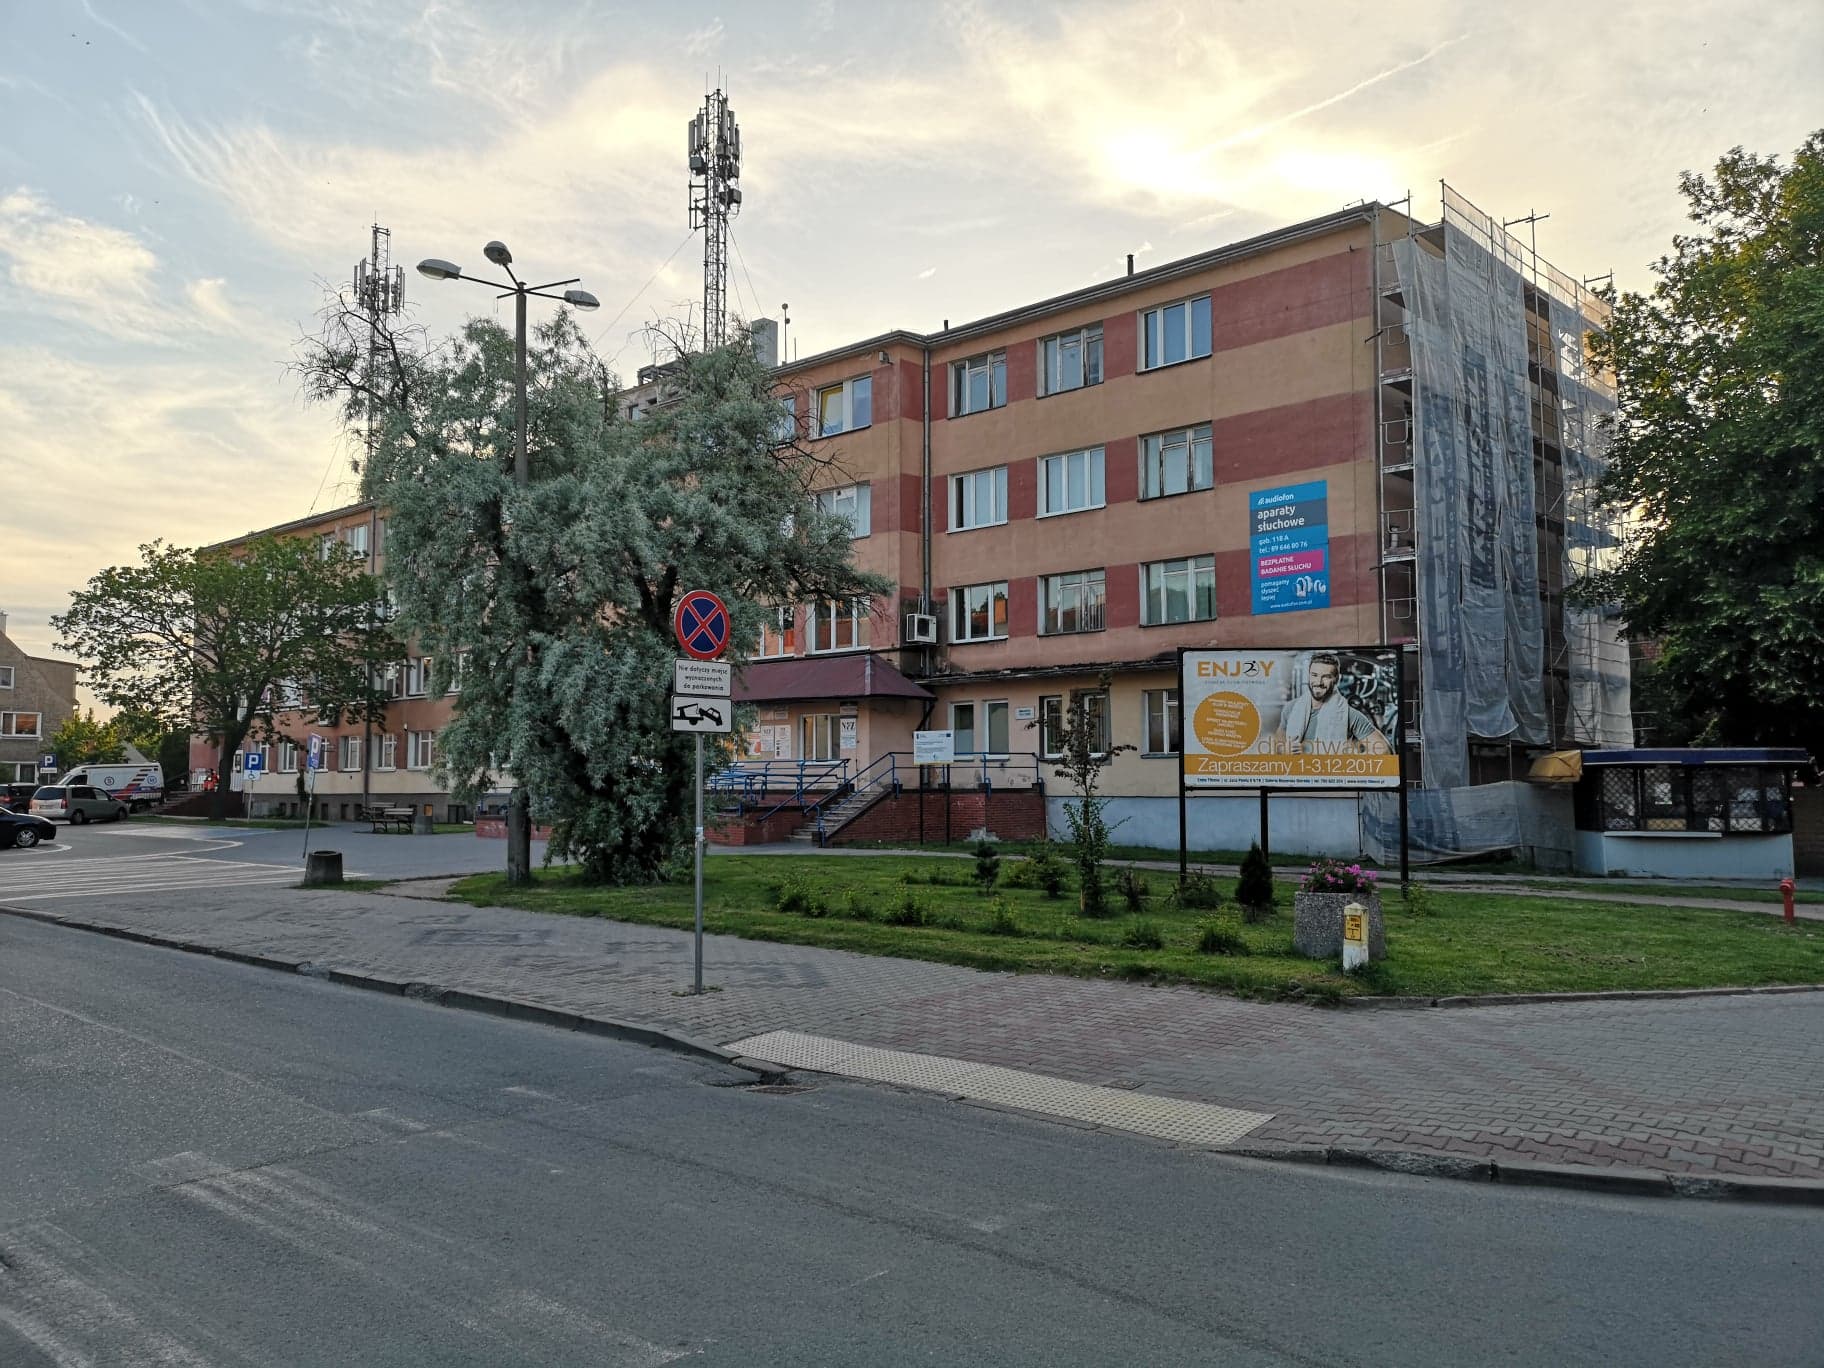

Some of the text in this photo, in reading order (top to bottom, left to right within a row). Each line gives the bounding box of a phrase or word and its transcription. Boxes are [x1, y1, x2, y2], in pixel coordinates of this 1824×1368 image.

[1265, 493, 1294, 505] audiofon
[1257, 505, 1296, 521] aparaty
[1257, 517, 1305, 533] słuchowe
[1260, 565, 1288, 575] BADANIE
[1260, 579, 1289, 588] pomagamy
[689, 665, 710, 674] dotyczy
[310, 736, 319, 757] P
[1257, 735, 1294, 755] dni
[1304, 737, 1384, 755] otwarte
[44, 755, 53, 767] P
[248, 754, 259, 768] P
[1198, 757, 1383, 776] Zapraszamy 1-3.12.2017
